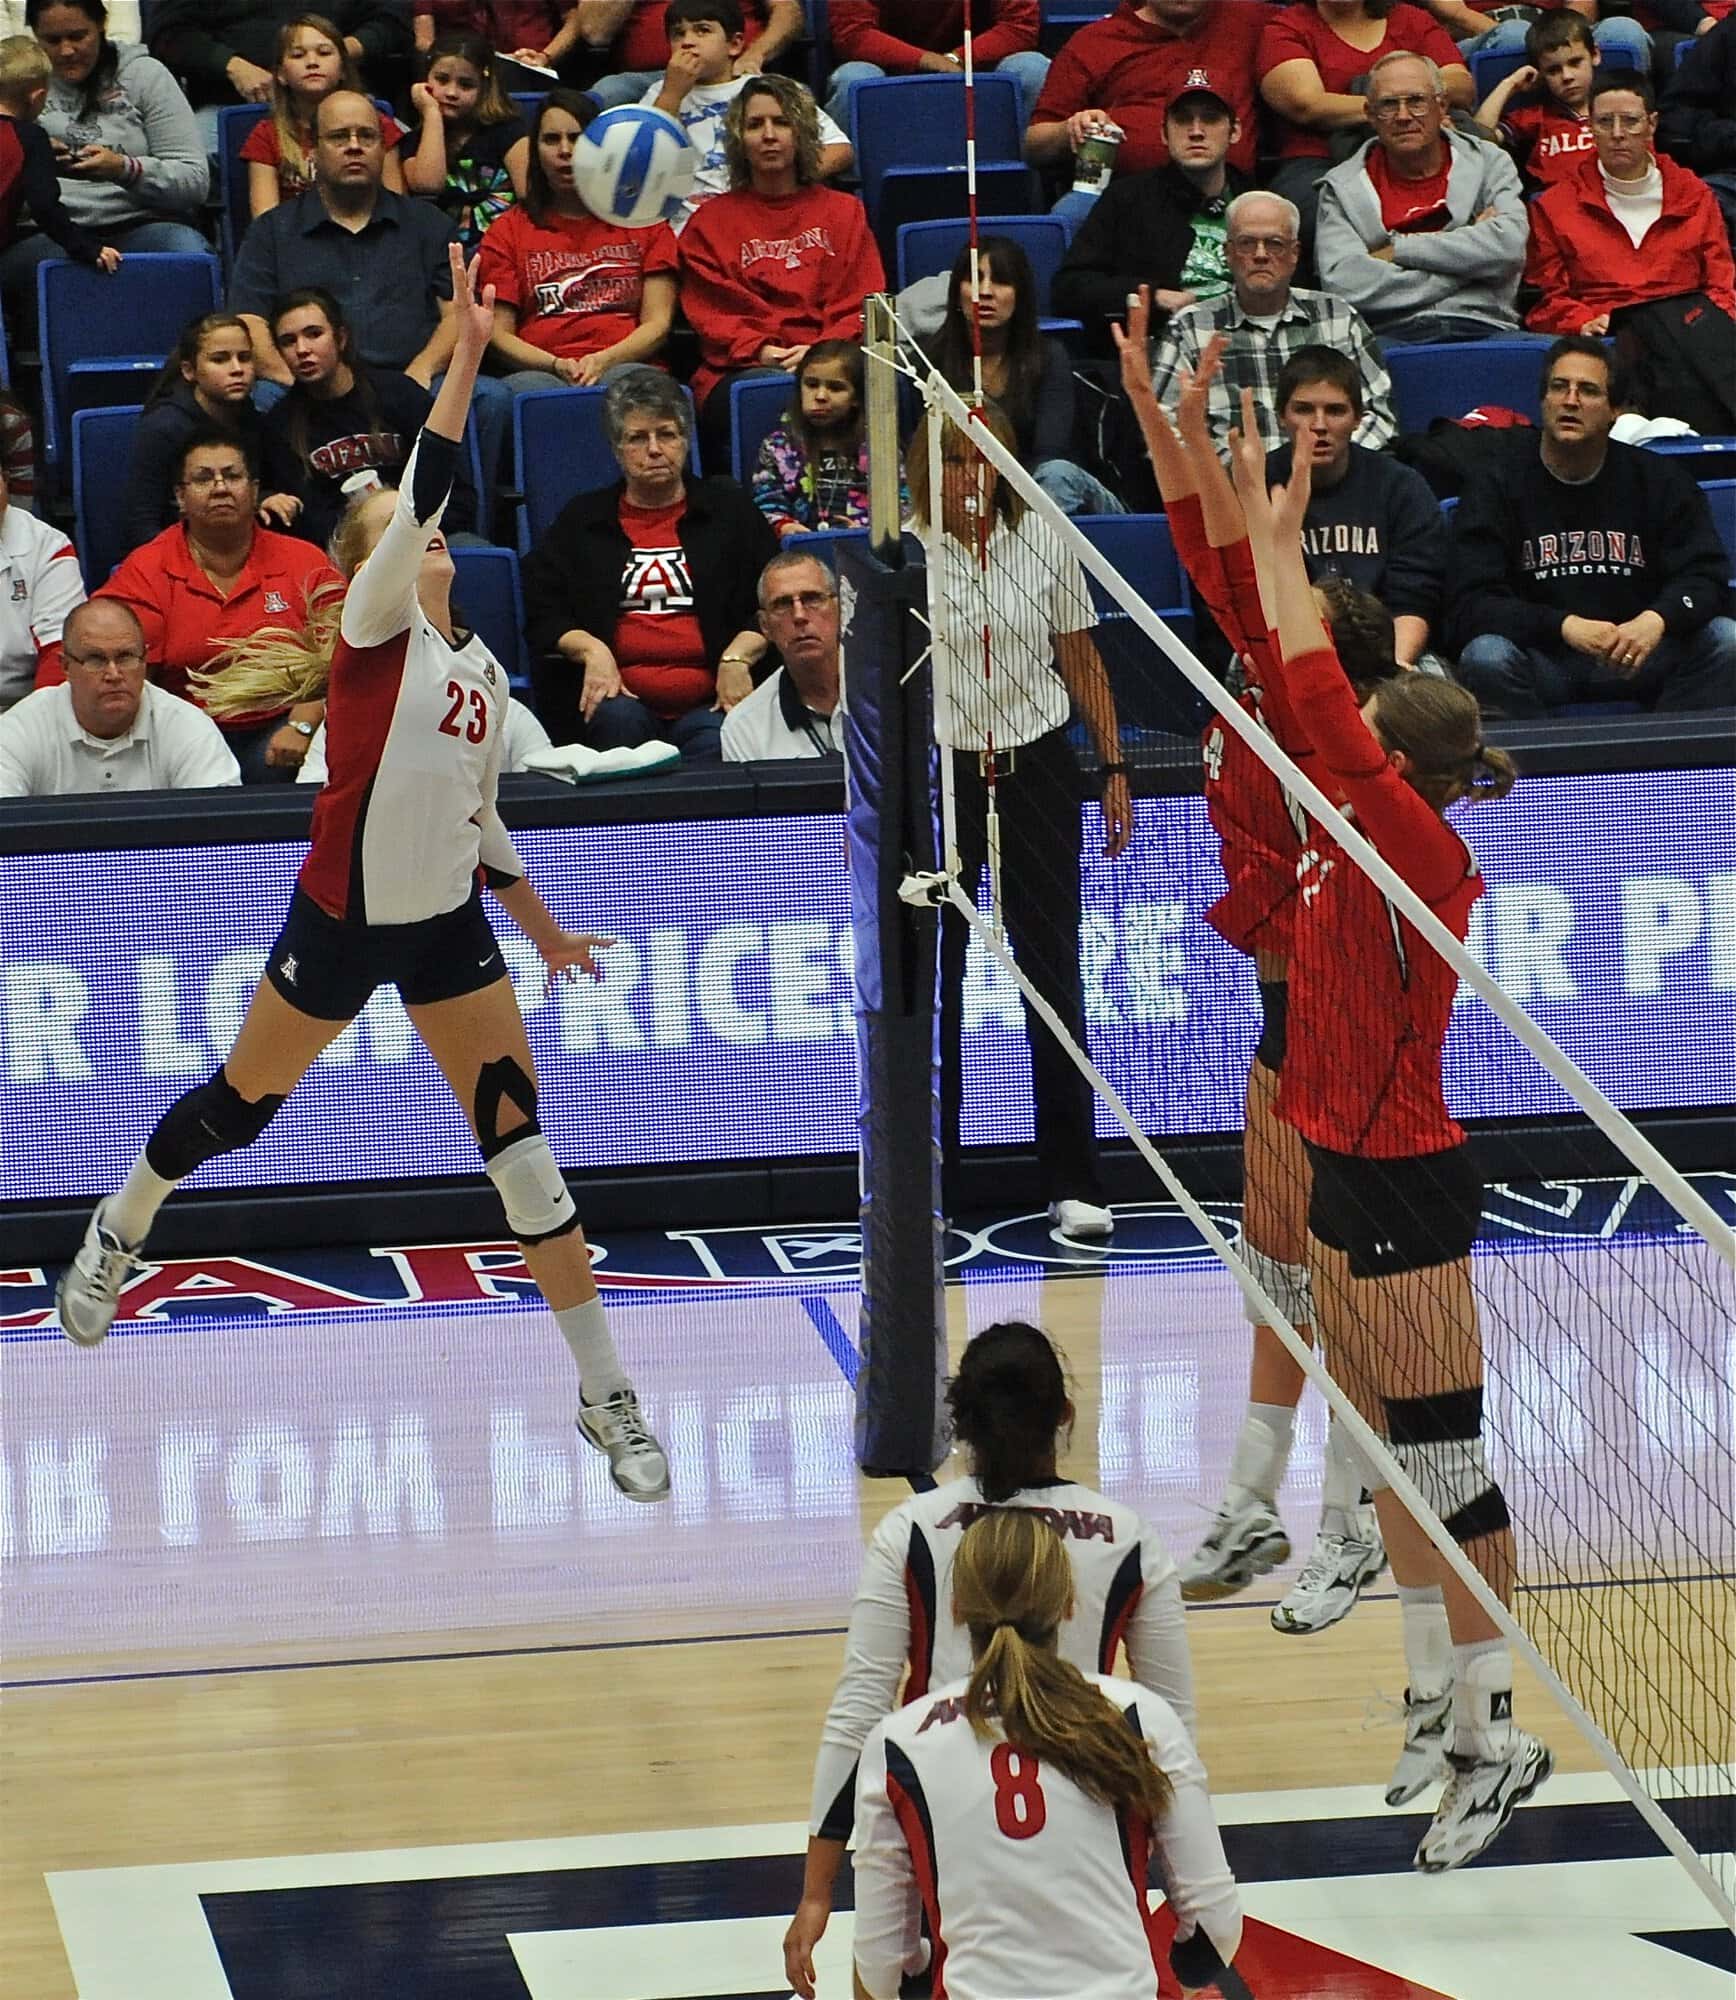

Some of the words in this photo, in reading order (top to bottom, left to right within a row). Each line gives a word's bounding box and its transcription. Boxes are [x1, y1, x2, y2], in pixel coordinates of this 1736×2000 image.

[1522, 530, 1647, 570] ARIZONA
[1534, 564, 1633, 581] WILDCATS
[437, 679, 488, 745] 23
[990, 1742, 1046, 1840] 8
